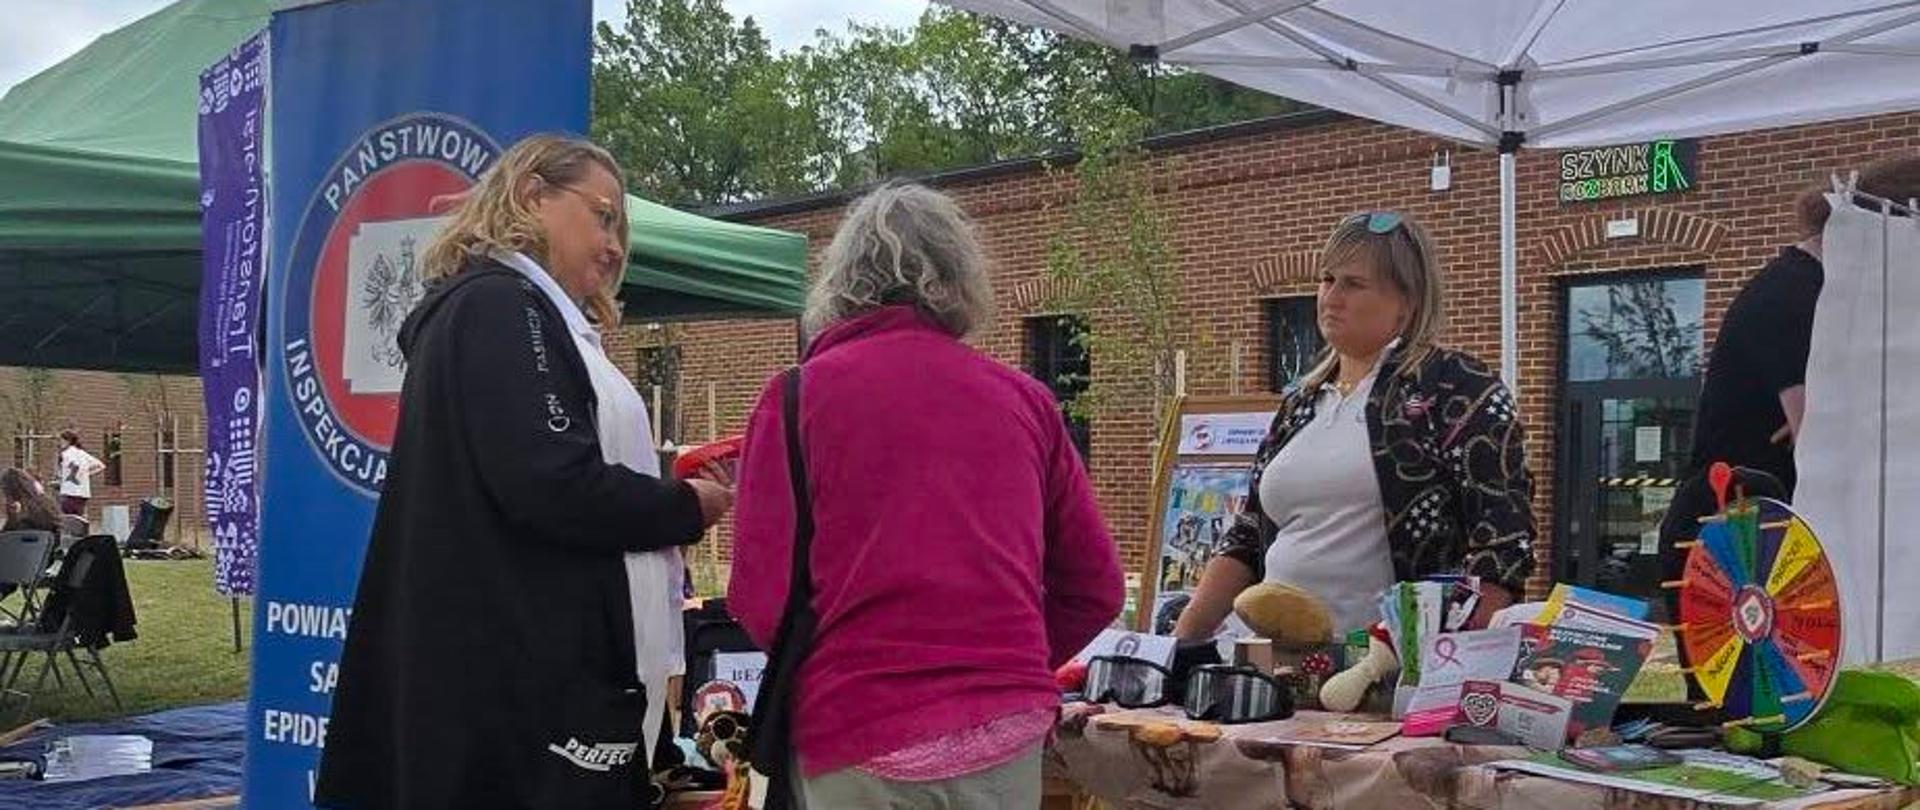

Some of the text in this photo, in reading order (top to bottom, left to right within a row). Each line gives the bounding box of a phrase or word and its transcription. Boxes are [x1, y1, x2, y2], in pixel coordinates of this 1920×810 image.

[324, 125, 489, 212] PAŃSTWOW
[1563, 146, 1648, 179] SZYNK
[286, 338, 388, 484] INSPEKCJA
[266, 601, 353, 639] POWIA
